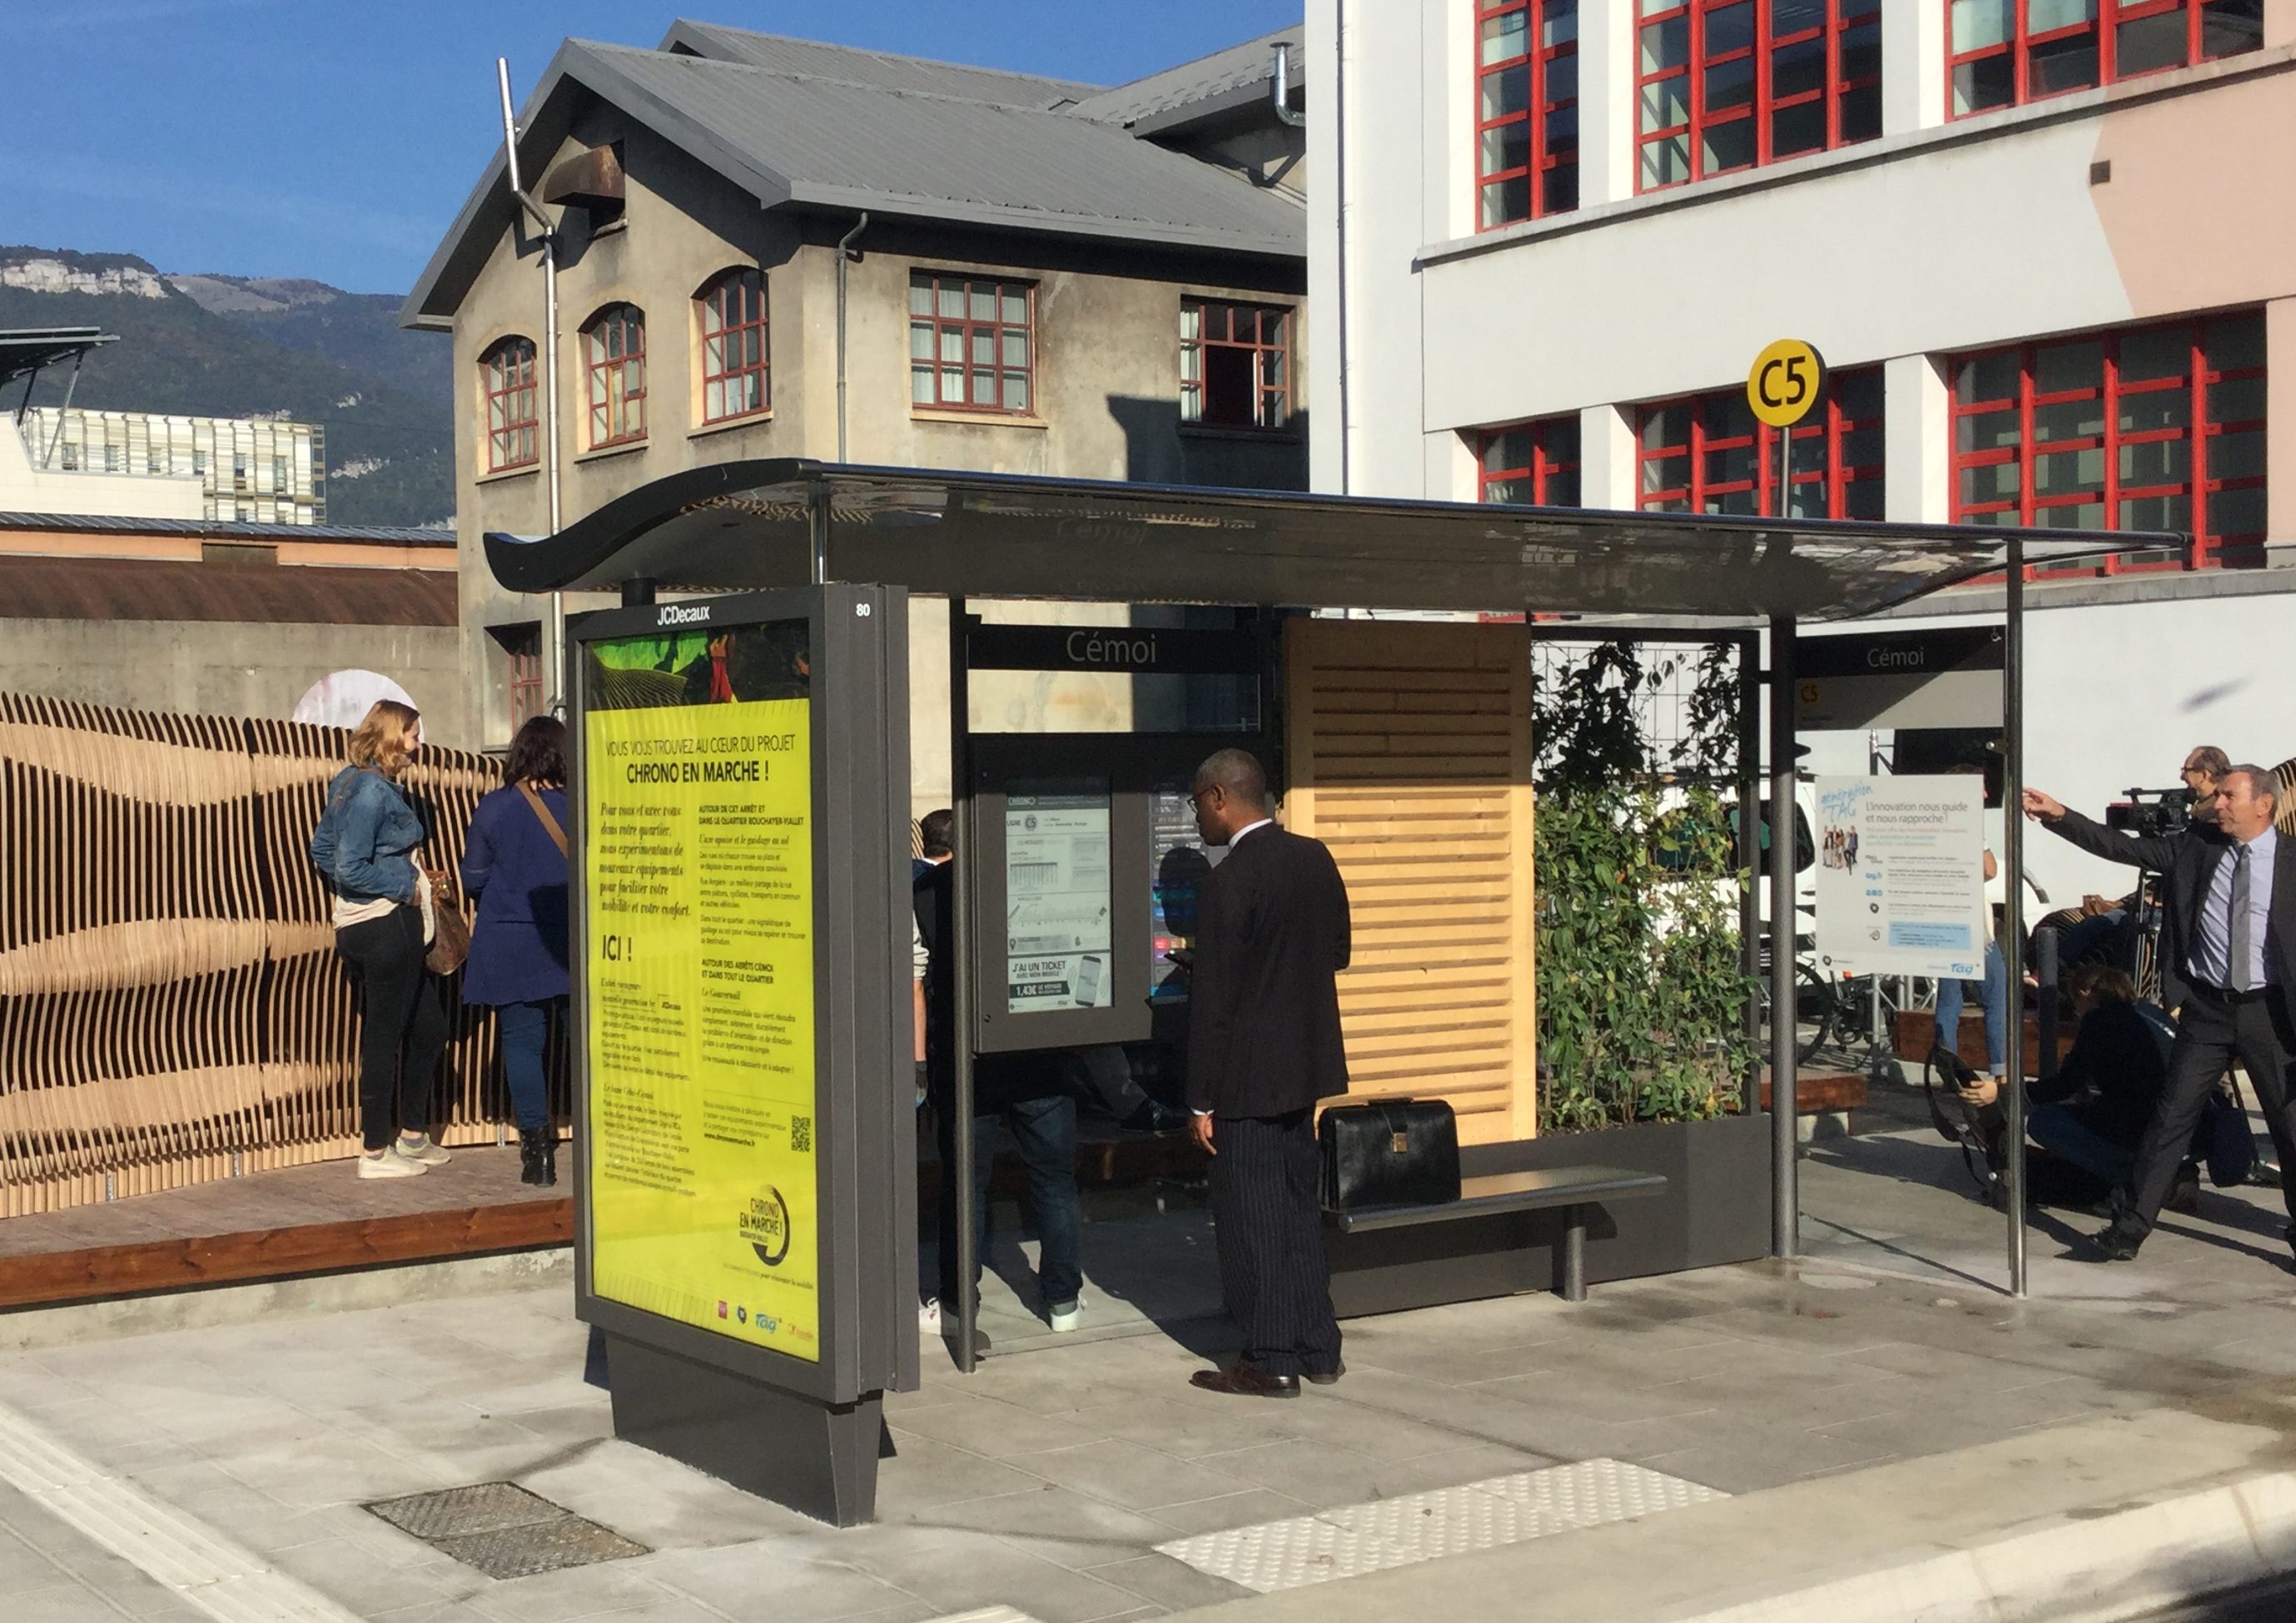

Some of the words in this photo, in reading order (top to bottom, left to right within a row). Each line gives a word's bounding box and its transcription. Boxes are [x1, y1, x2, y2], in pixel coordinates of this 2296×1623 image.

[1758, 355, 1806, 408] C5
[658, 605, 710, 626] JCDecaux
[856, 603, 871, 617] 80
[1066, 630, 1156, 664] Cémoi
[1866, 645, 1925, 668] Cémoi
[1800, 684, 1819, 703] C5
[606, 741, 629, 757] VOUS
[632, 740, 653, 756] VOUS
[654, 738, 693, 755] TROUVEZ
[696, 738, 708, 753] AU
[741, 736, 756, 752] DU
[758, 734, 796, 752] PROJET
[626, 762, 679, 783] CHRONO
[683, 762, 699, 782] EN
[703, 761, 759, 782] MARCHE
[764, 760, 769, 781] !
[758, 805, 765, 813] ET
[1866, 802, 1917, 812] L'innovation
[1918, 803, 1940, 812] nous
[1941, 802, 1968, 814] guide
[1866, 814, 1875, 823] et
[1876, 815, 1898, 823] nous
[1899, 813, 1944, 826] rapproche
[603, 935, 621, 961] ICI
[628, 936, 632, 962] !
[1028, 962, 1040, 971] UN
[1041, 960, 1066, 970] TICKET
[1951, 962, 1973, 975] Tag
[751, 1198, 779, 1218] CHRONO
[740, 1212, 748, 1228] EN
[750, 1214, 778, 1236] MARCHE
[755, 1313, 777, 1333] Tag
